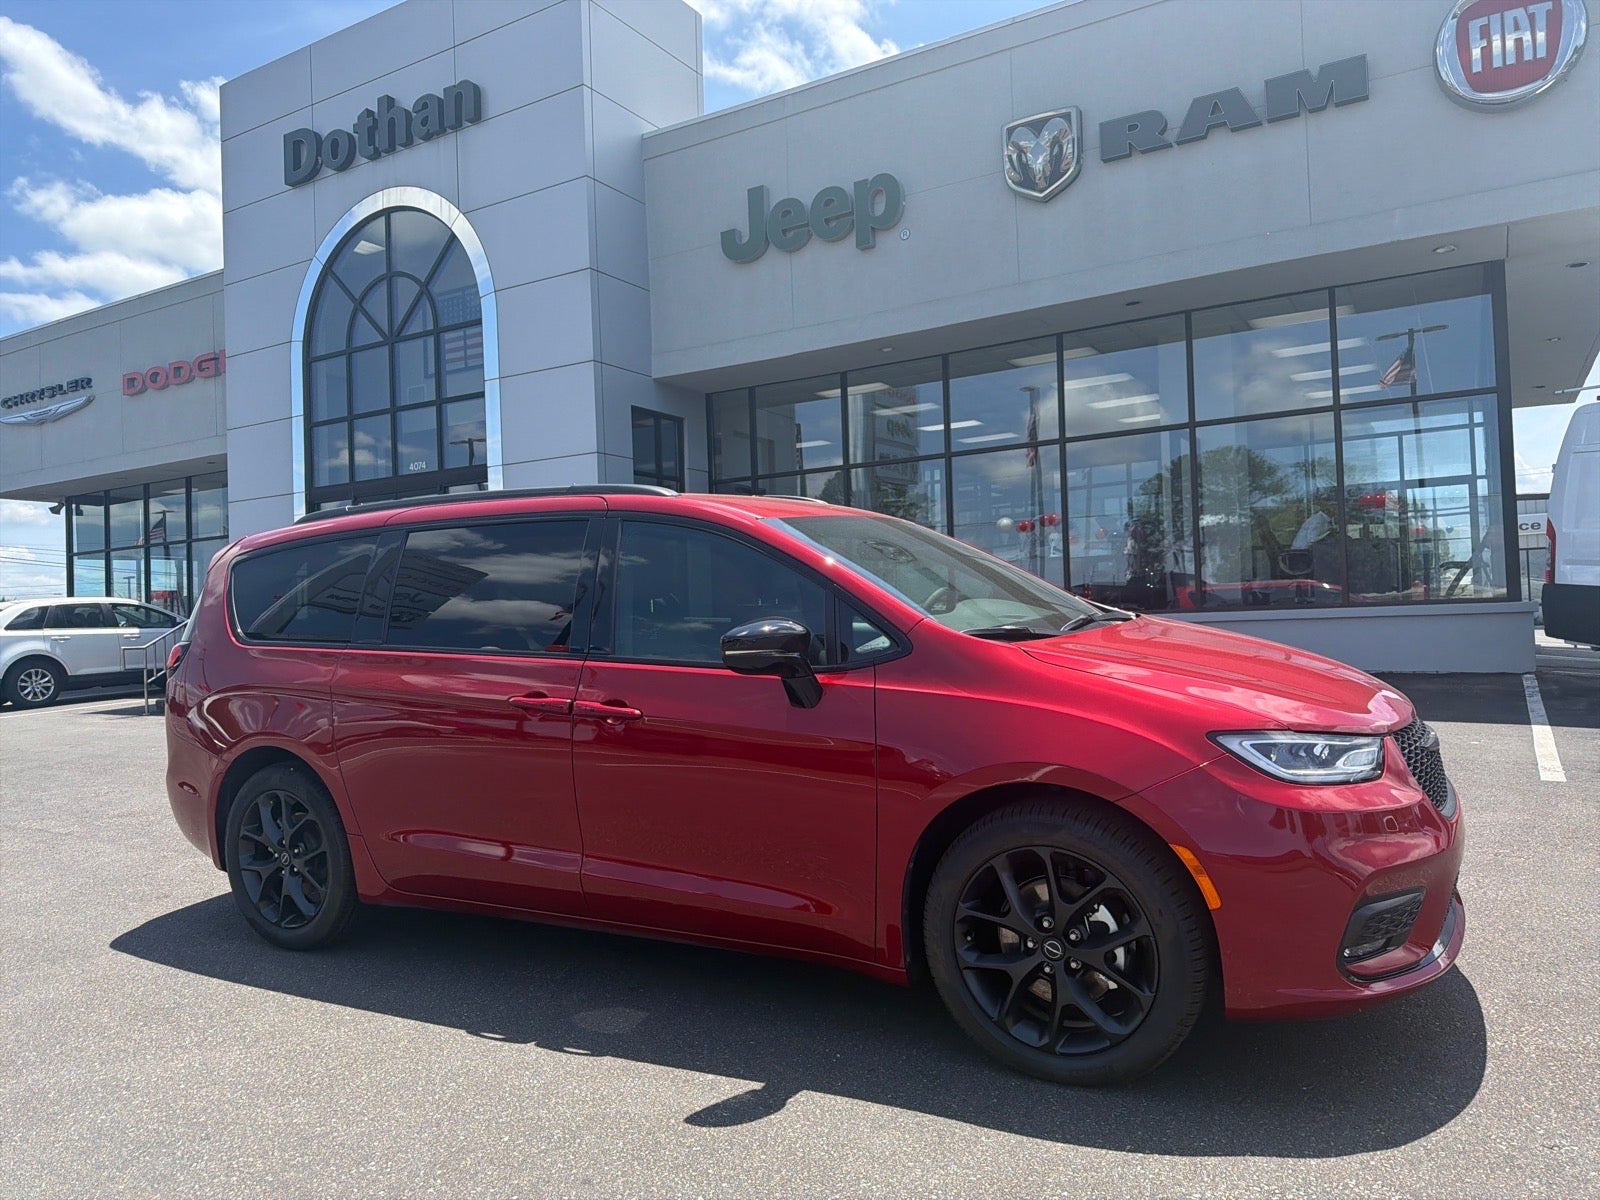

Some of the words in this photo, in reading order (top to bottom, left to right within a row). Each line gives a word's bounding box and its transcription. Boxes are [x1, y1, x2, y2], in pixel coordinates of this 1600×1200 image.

[1469, 2, 1552, 74] FIAT
[283, 79, 482, 187] Dothan
[1100, 54, 1369, 163] RAM
[720, 173, 904, 264] Jeep
[0, 377, 93, 409] CHRYSLER
[409, 461, 426, 471] 4074
